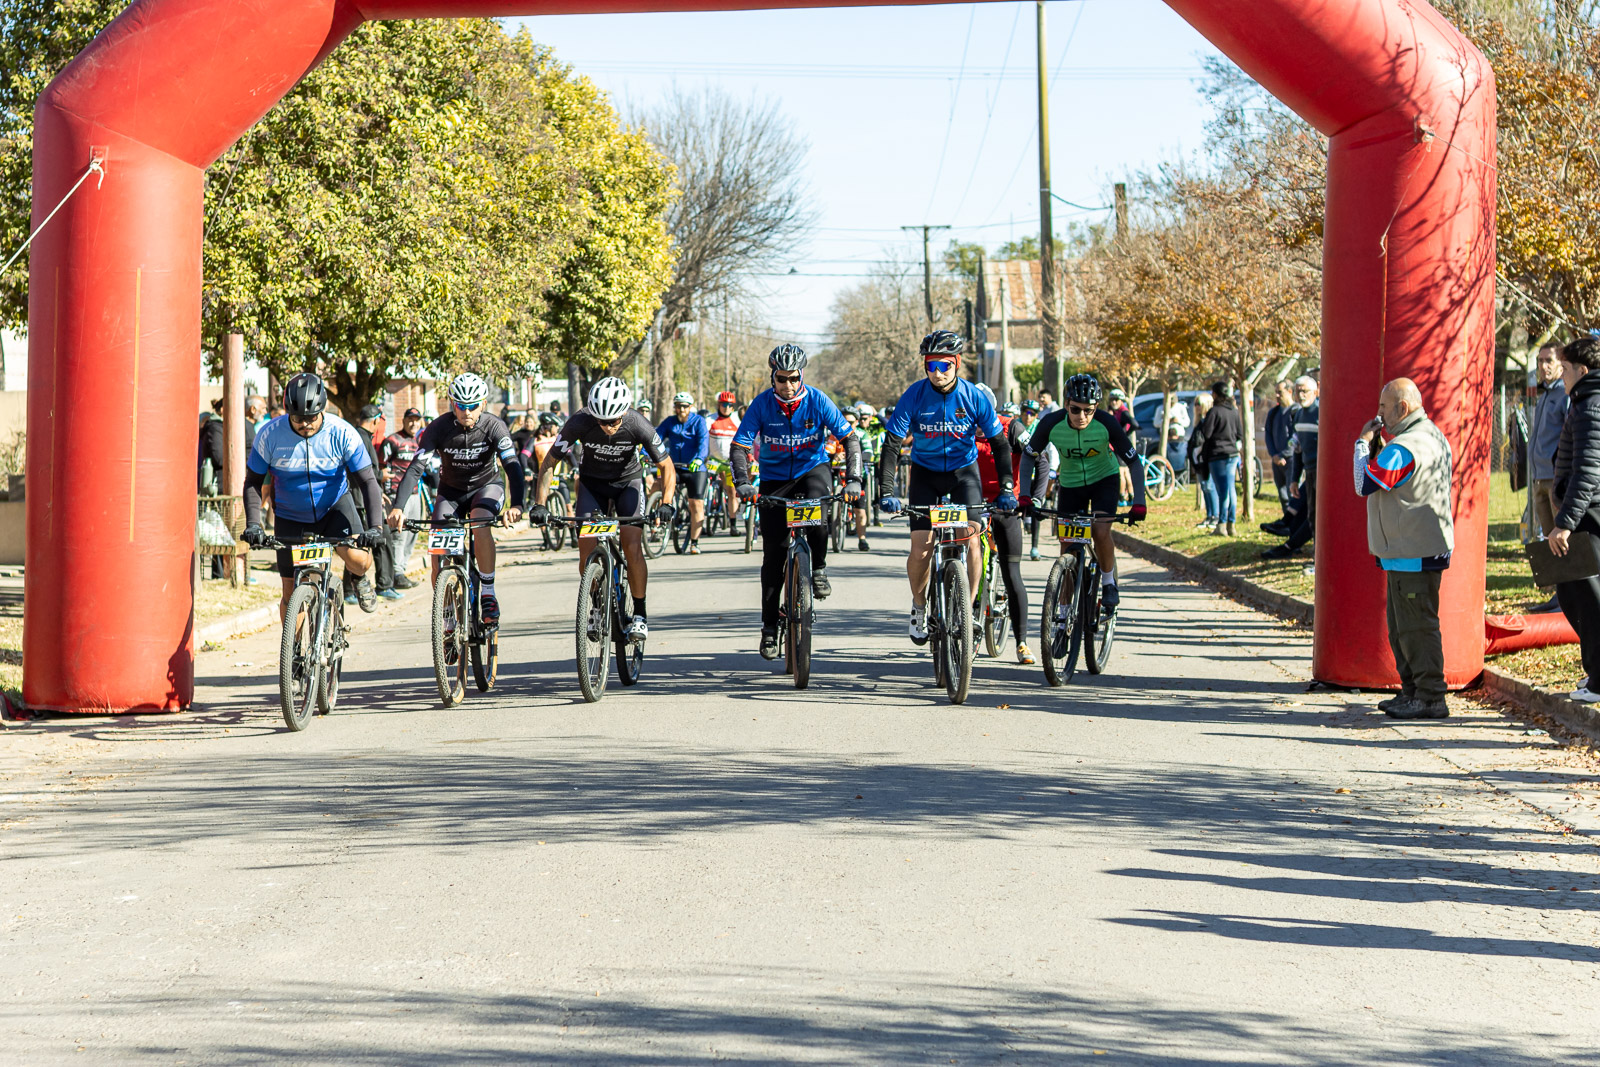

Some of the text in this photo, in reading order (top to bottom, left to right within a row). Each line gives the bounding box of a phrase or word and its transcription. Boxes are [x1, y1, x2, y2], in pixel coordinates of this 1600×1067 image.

[919, 422, 970, 433] PELOTON
[763, 433, 819, 447] PELOTON
[443, 446, 489, 455] NACHOS
[583, 442, 635, 452] NACHOS
[770, 441, 816, 454] BRUTAL
[1059, 447, 1101, 459] USA
[274, 457, 338, 469] GIANT
[793, 506, 816, 521] 97
[937, 510, 961, 522] 98
[588, 525, 613, 534] 113
[1063, 525, 1086, 538] 119
[431, 535, 461, 548] 215
[300, 548, 325, 560] 101
